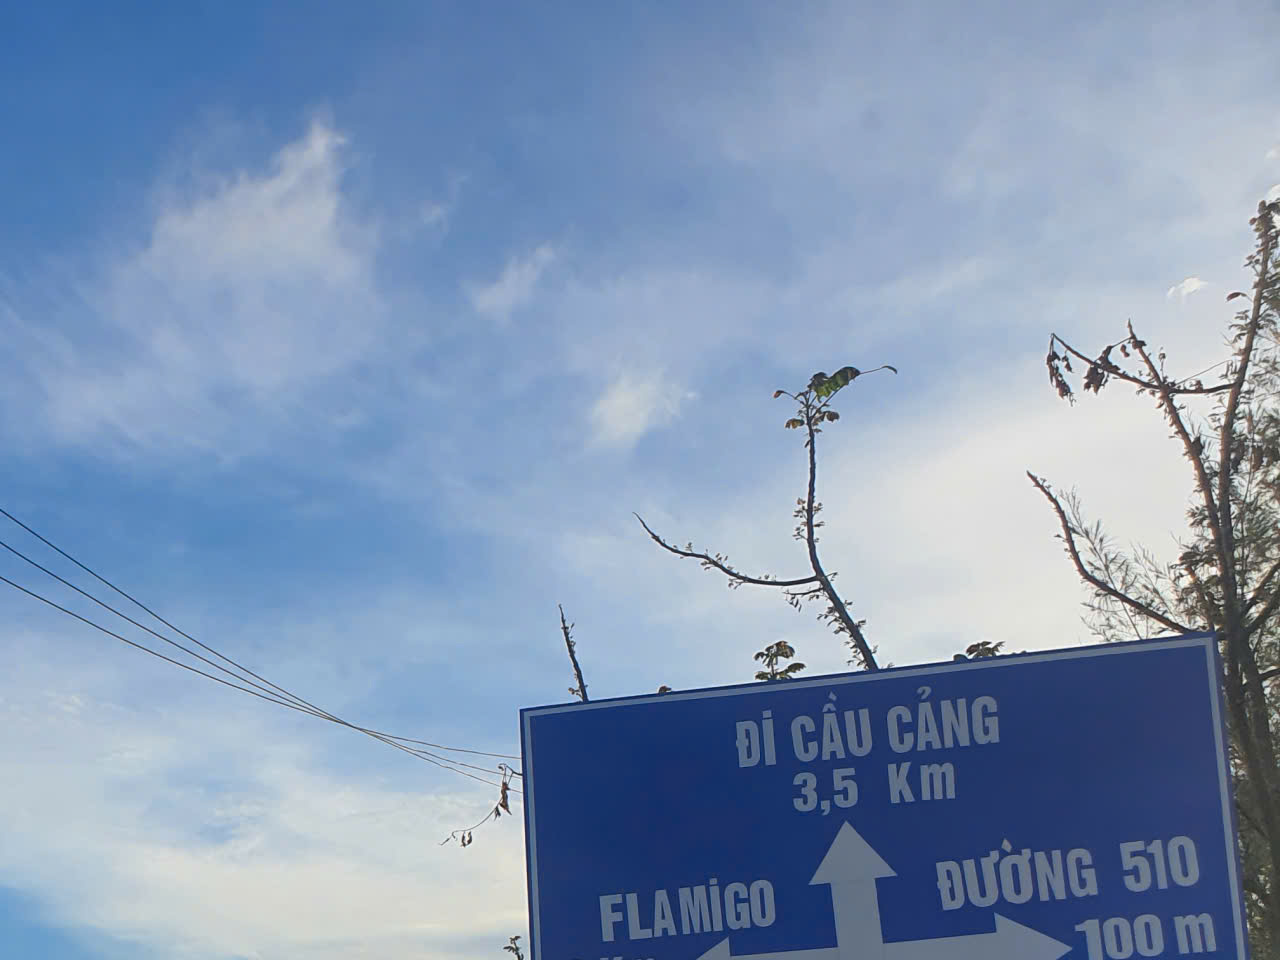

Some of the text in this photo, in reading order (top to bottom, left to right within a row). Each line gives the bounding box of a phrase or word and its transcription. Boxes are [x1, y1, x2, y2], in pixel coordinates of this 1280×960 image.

[791, 691, 873, 762] CẦU
[886, 686, 1000, 754] CẢNG
[792, 761, 956, 816] 3,5 Km
[935, 836, 1200, 911] ĐƯỜNG 510
[1173, 912, 1217, 955] m
